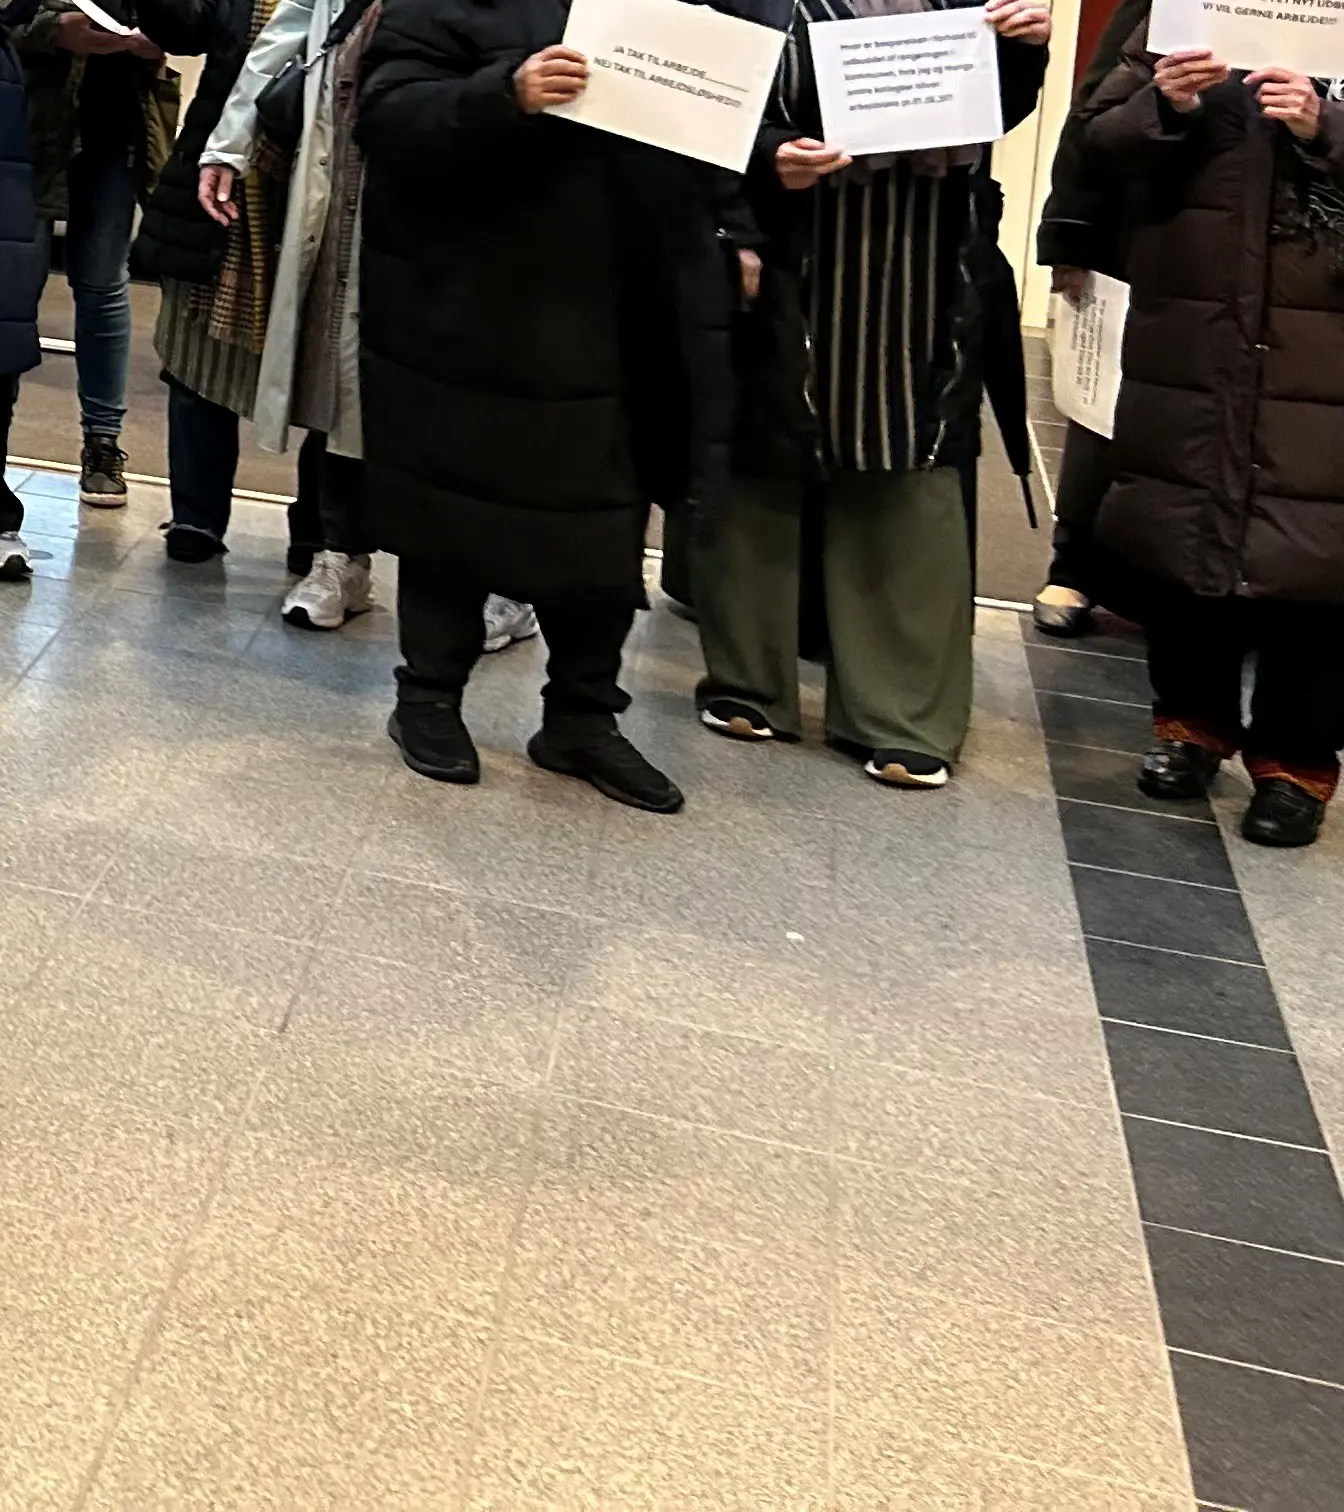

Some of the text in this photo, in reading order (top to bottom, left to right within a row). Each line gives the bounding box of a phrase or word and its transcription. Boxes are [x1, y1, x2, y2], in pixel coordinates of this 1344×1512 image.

[1202, 1, 1274, 20] VI VIL GERNE
[613, 45, 661, 66] JA TAK TIL
[593, 56, 648, 80] NEJ TAK TIL
